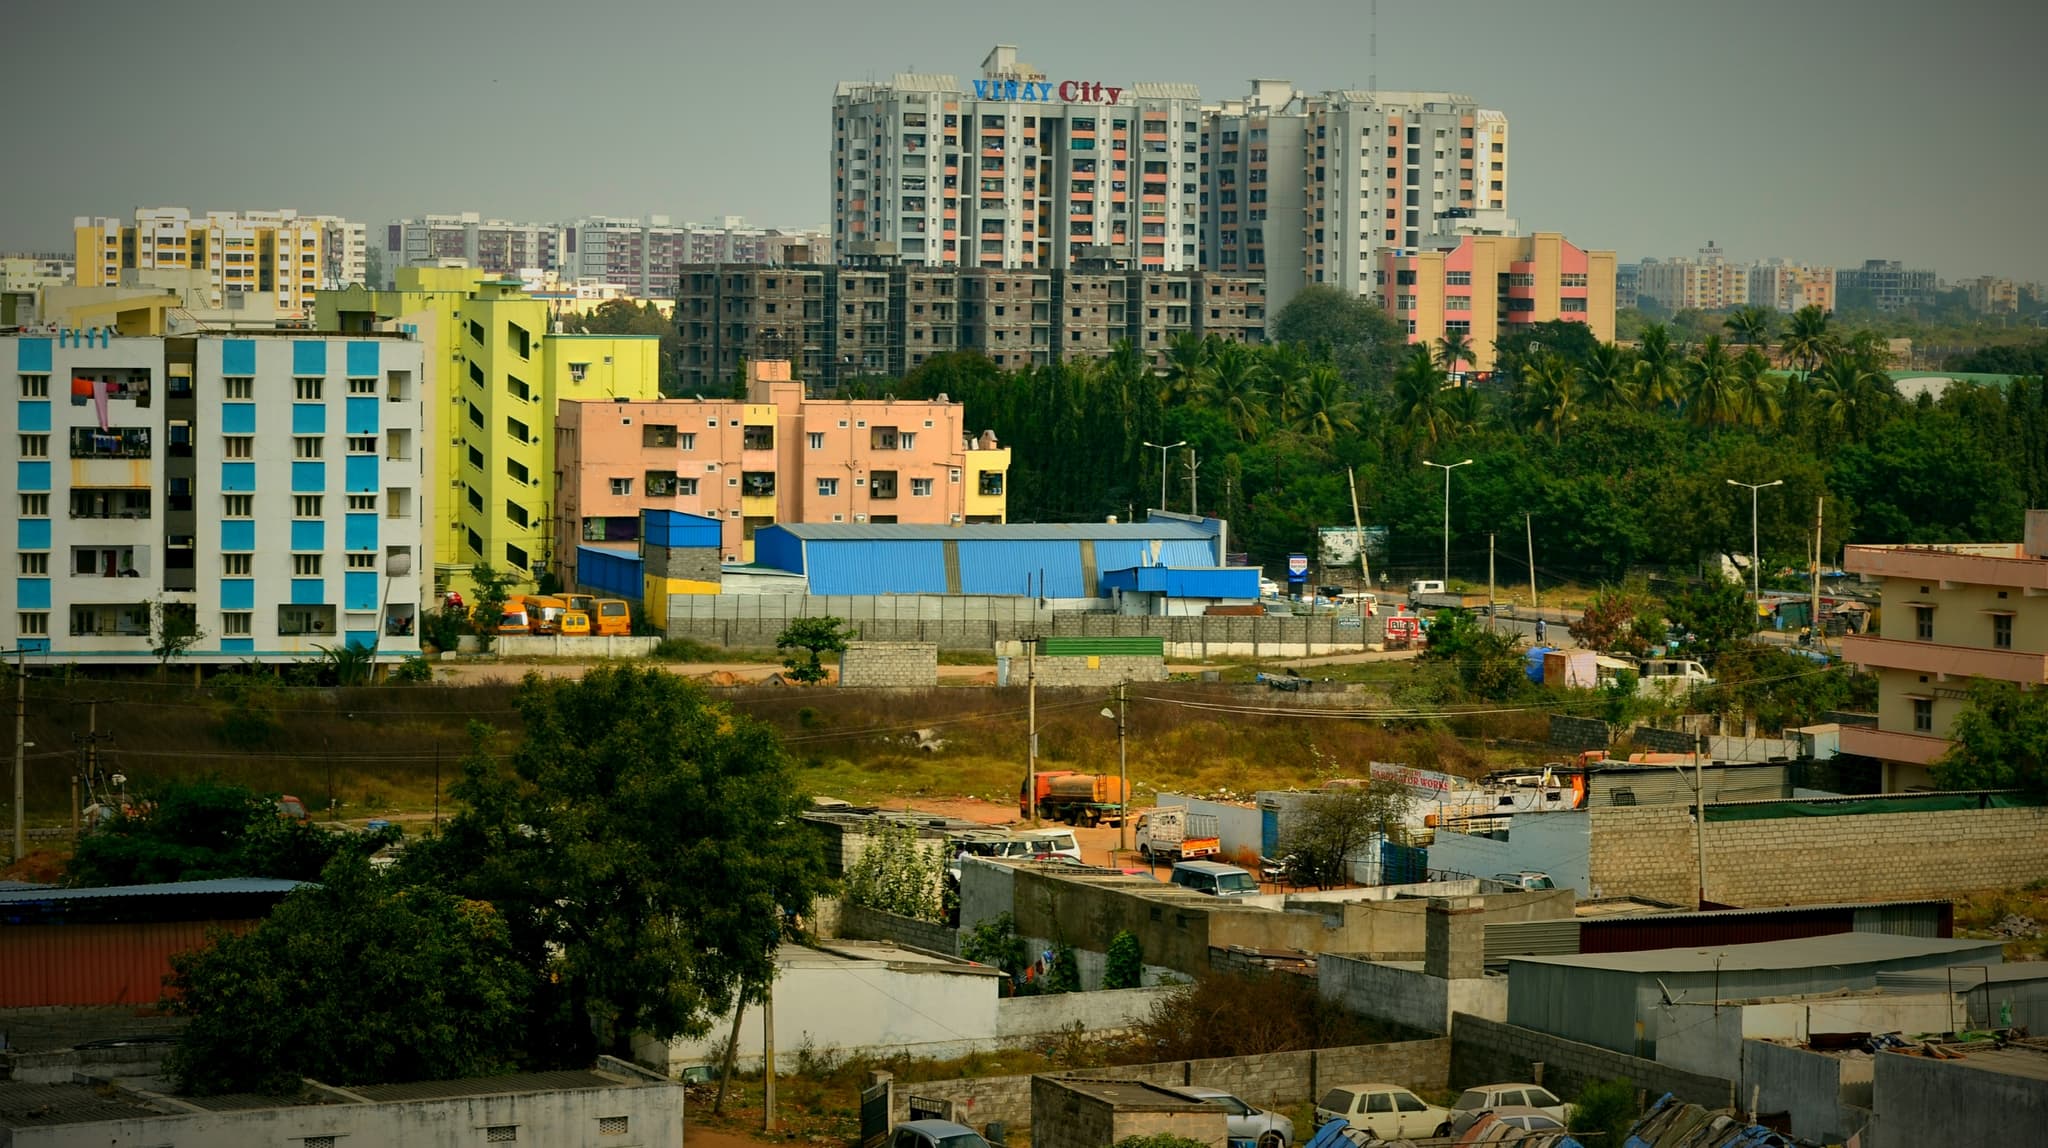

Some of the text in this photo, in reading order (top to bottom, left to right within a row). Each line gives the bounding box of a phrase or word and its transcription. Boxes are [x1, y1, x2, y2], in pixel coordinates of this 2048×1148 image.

[972, 79, 1123, 105] VINAY City
[1421, 777, 1448, 791] WORKS
